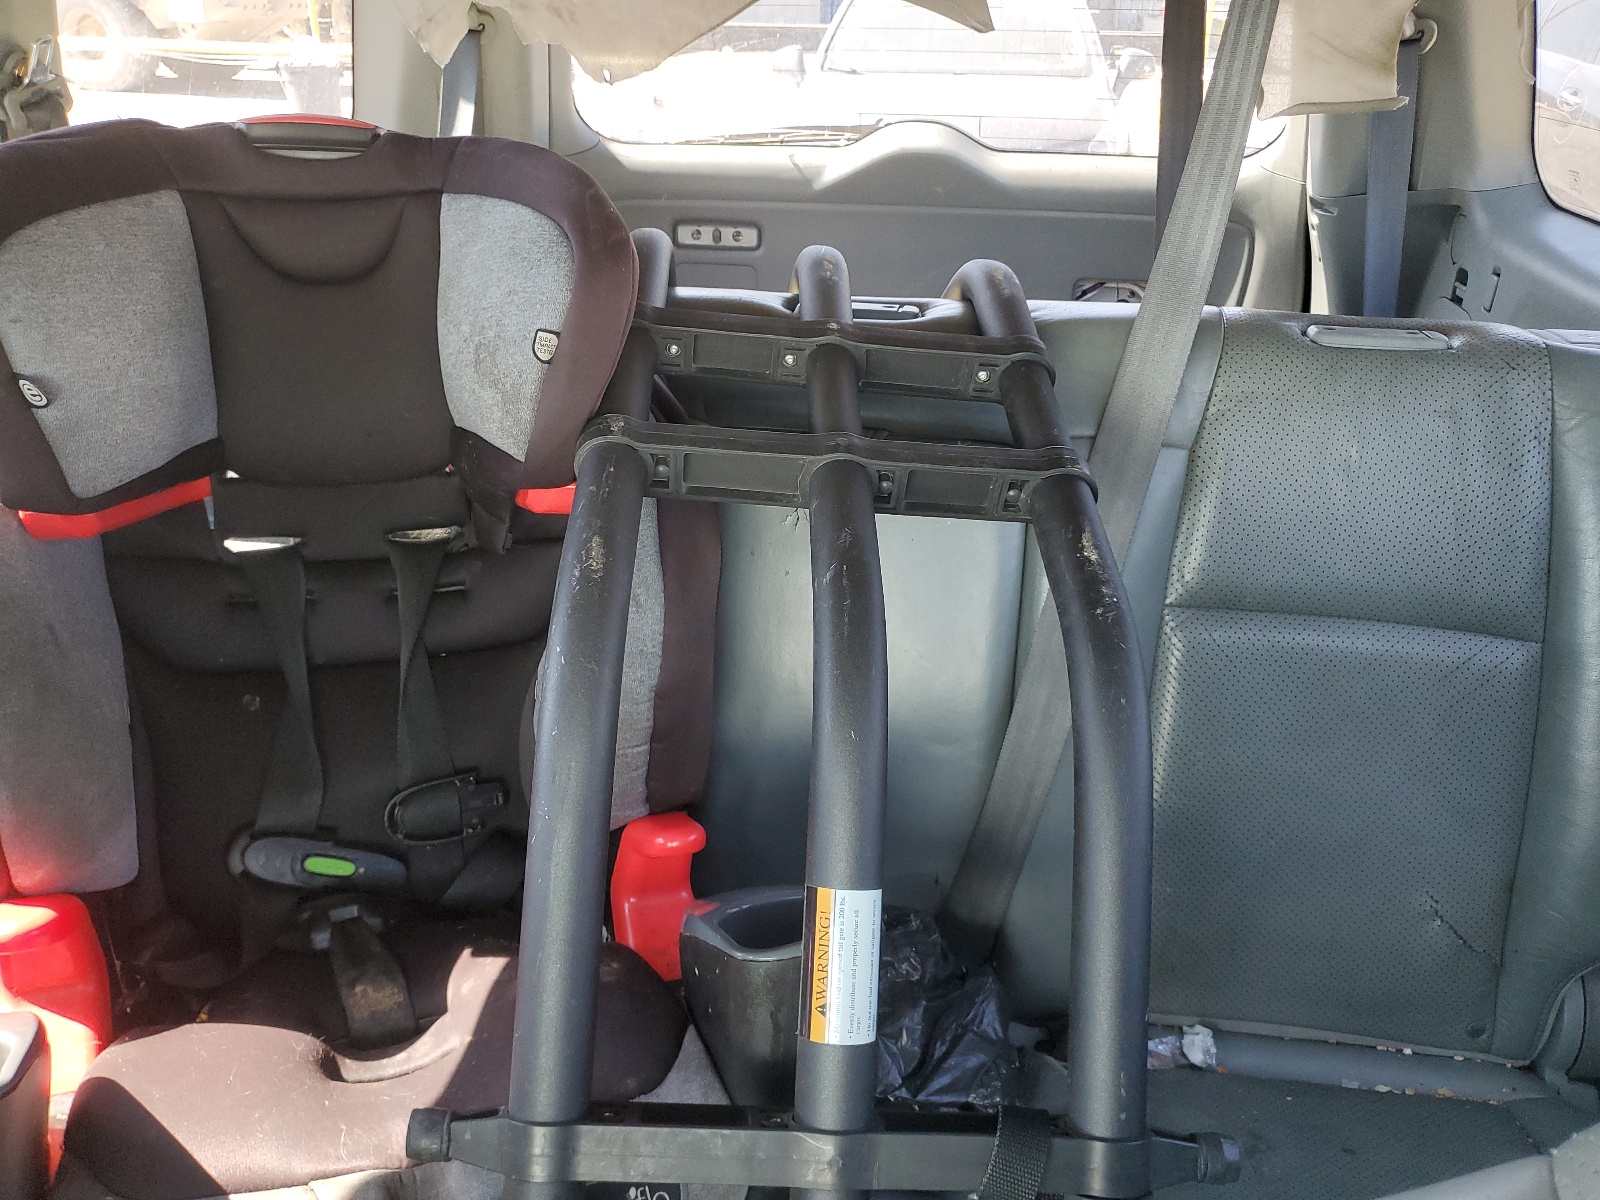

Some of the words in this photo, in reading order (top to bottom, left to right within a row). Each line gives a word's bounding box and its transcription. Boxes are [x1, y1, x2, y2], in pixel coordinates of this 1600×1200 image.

[538, 335, 553, 343] SIDE
[816, 910, 831, 1001] WARNING!
[851, 940, 859, 967] properly
[833, 1001, 841, 1034] Maimum
[847, 1013, 856, 1034] Evenly
